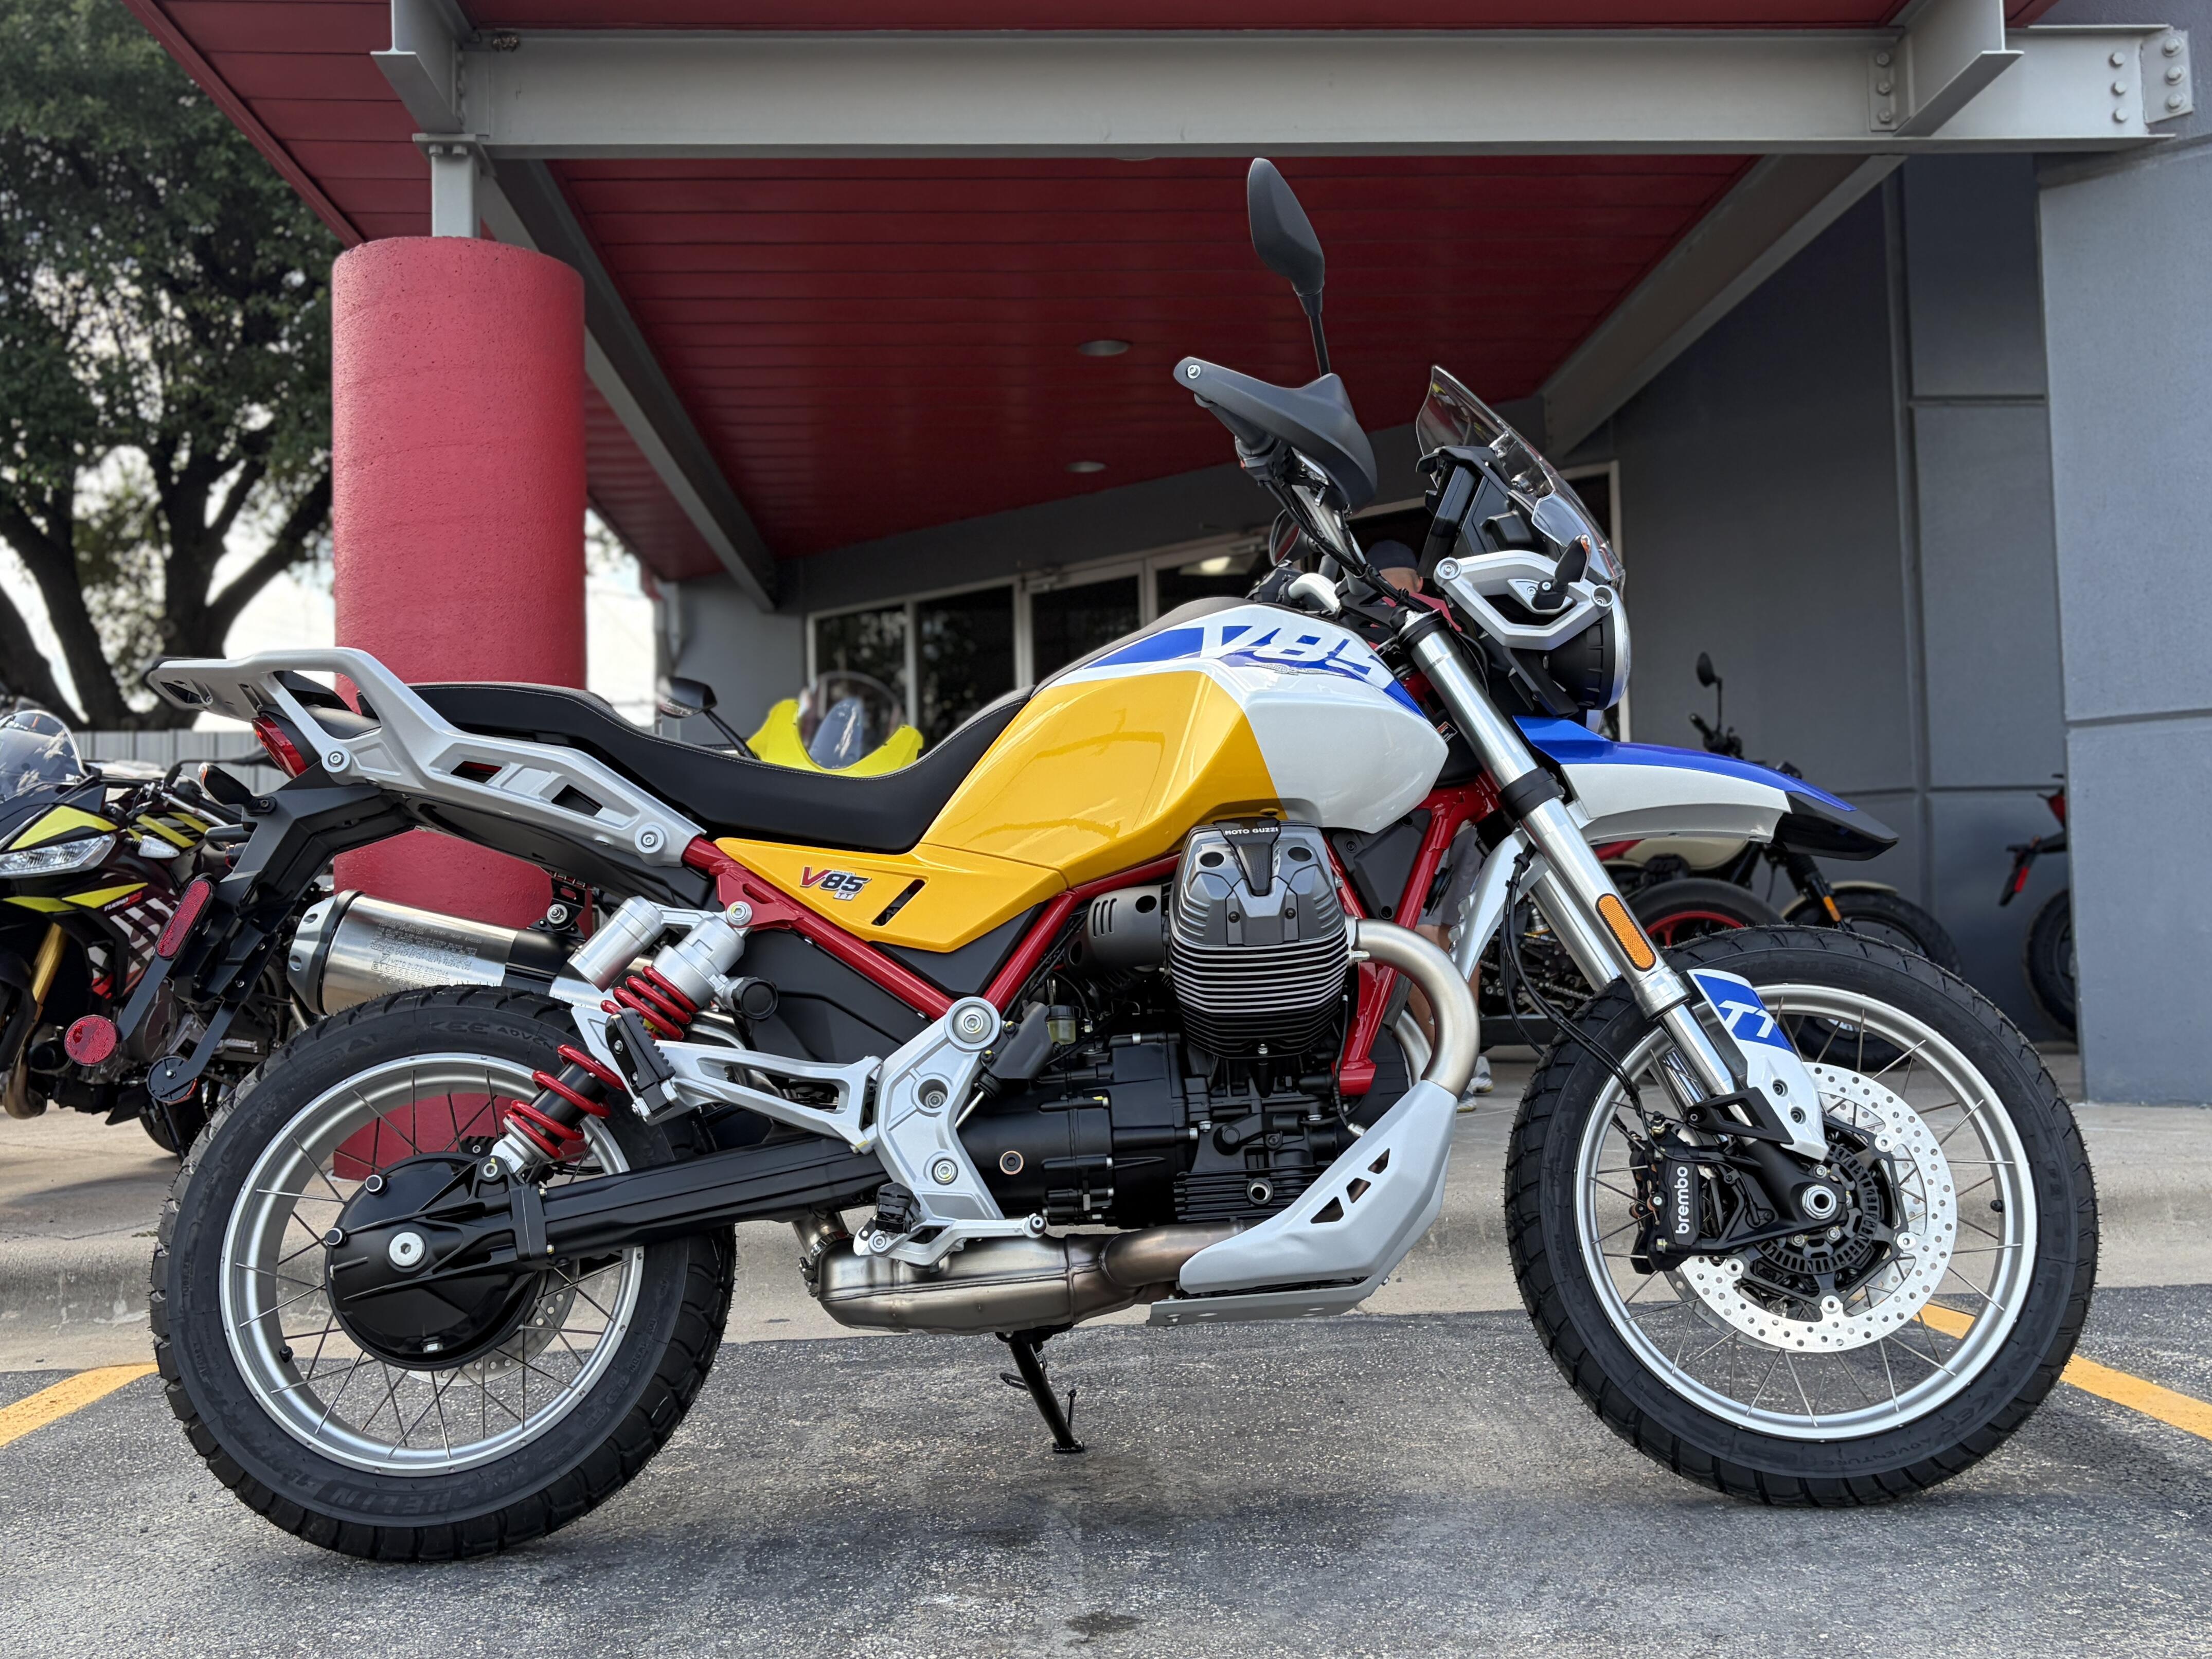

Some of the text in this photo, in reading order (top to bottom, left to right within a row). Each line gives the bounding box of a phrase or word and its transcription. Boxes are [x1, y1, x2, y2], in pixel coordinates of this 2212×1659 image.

[1200, 624, 1395, 689] V85
[801, 866, 869, 893] V85
[1674, 1166, 1690, 1234] brembo
[1824, 1435, 1932, 1466] ADVENTURE
